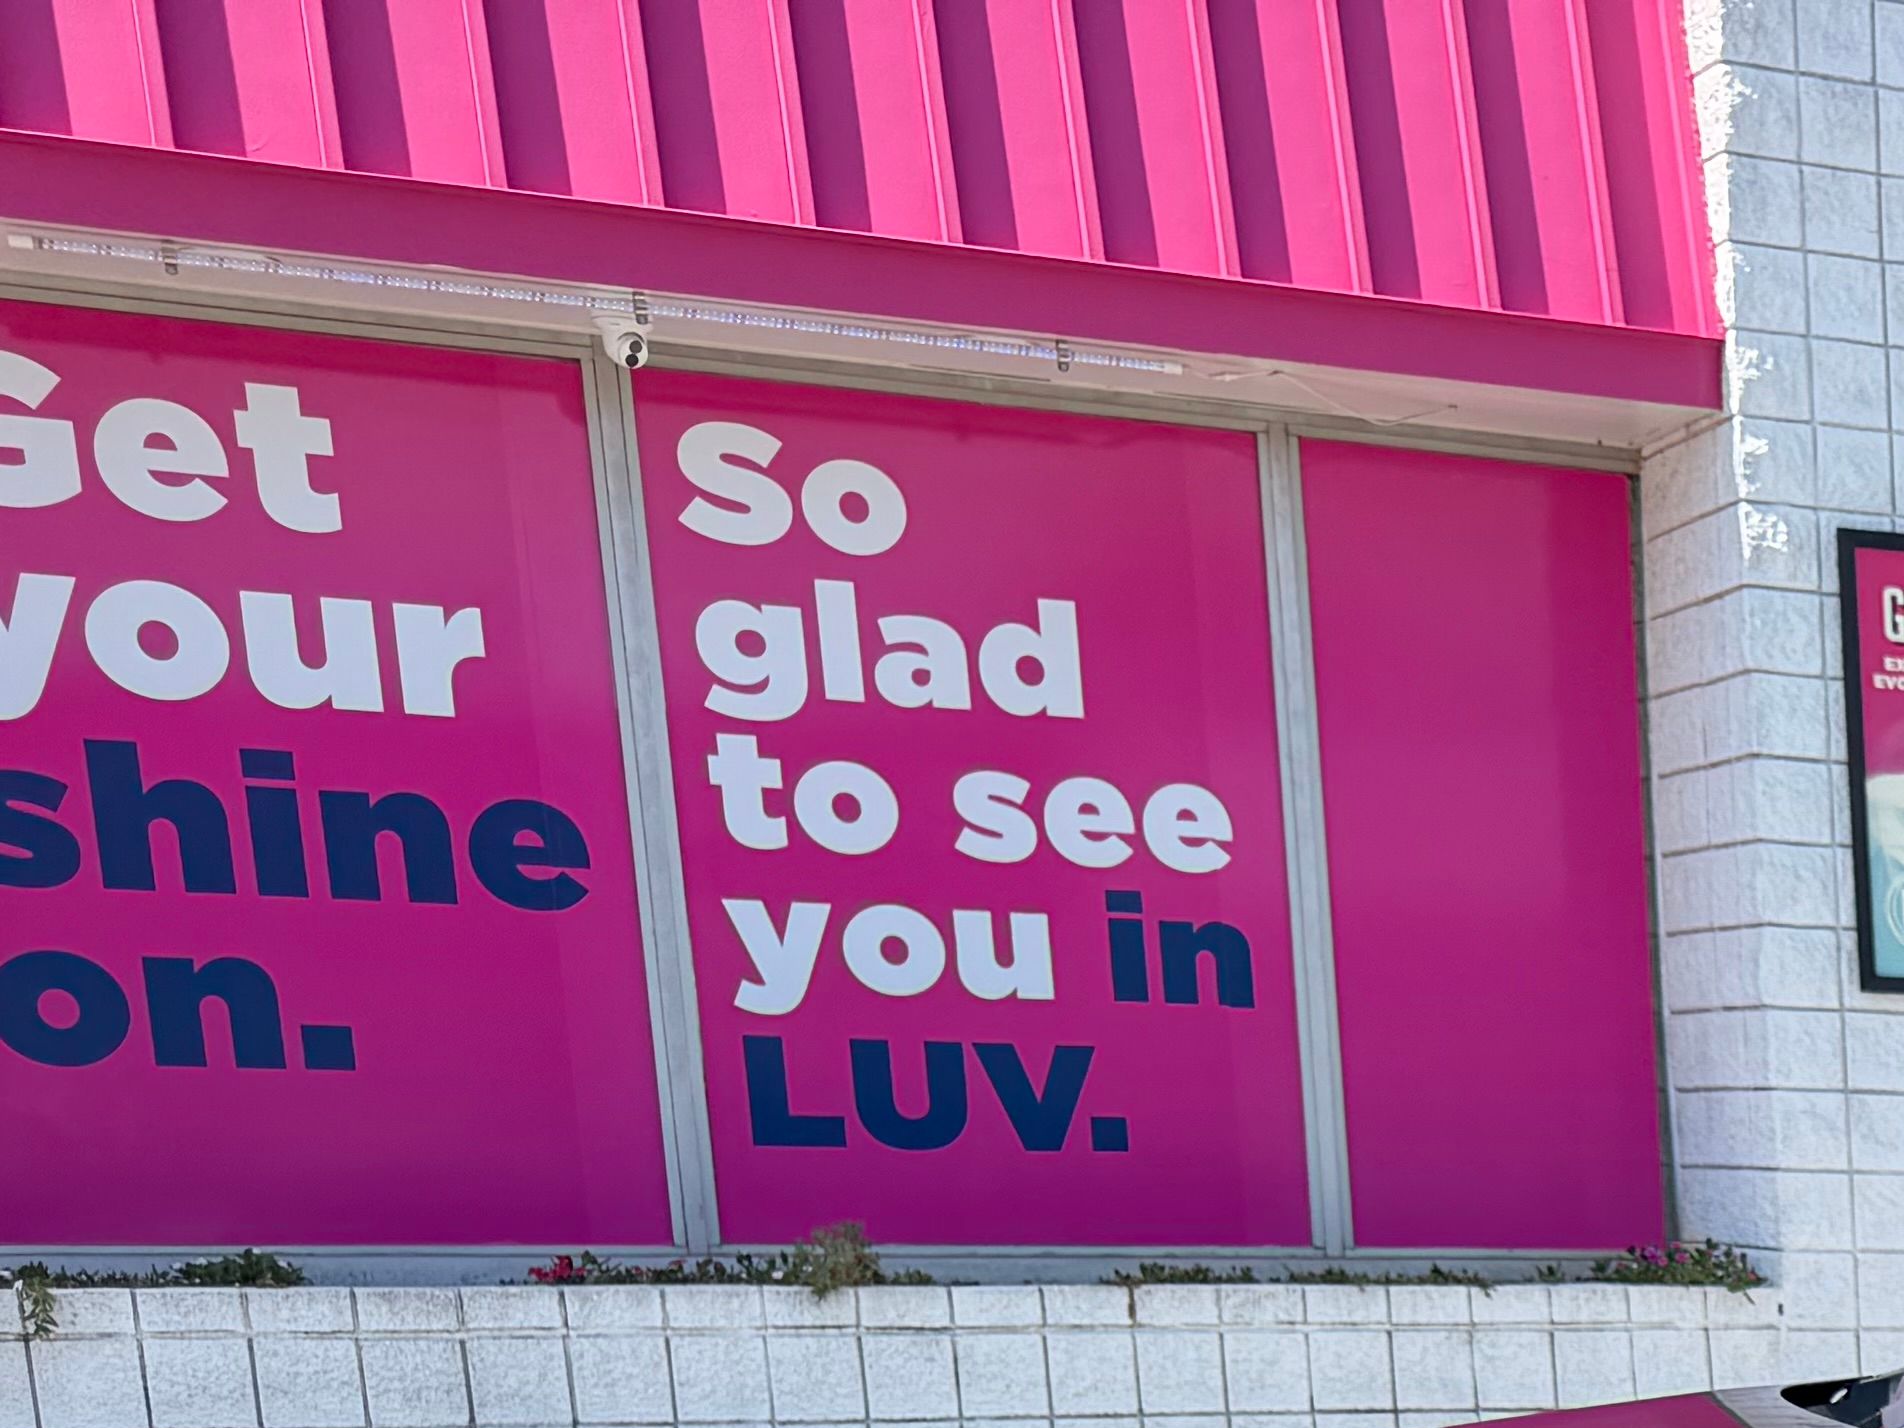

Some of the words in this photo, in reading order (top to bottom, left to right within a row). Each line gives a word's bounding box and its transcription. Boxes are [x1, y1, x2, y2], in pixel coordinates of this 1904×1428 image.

[677, 421, 907, 555] So
[695, 579, 1084, 721] glad
[0, 739, 590, 911] shine
[708, 733, 899, 855] to
[953, 770, 1234, 873] see
[0, 950, 356, 1070] on.
[722, 898, 1054, 1015] you
[1106, 890, 1255, 1009] in
[743, 1035, 1129, 1152] LUV.
